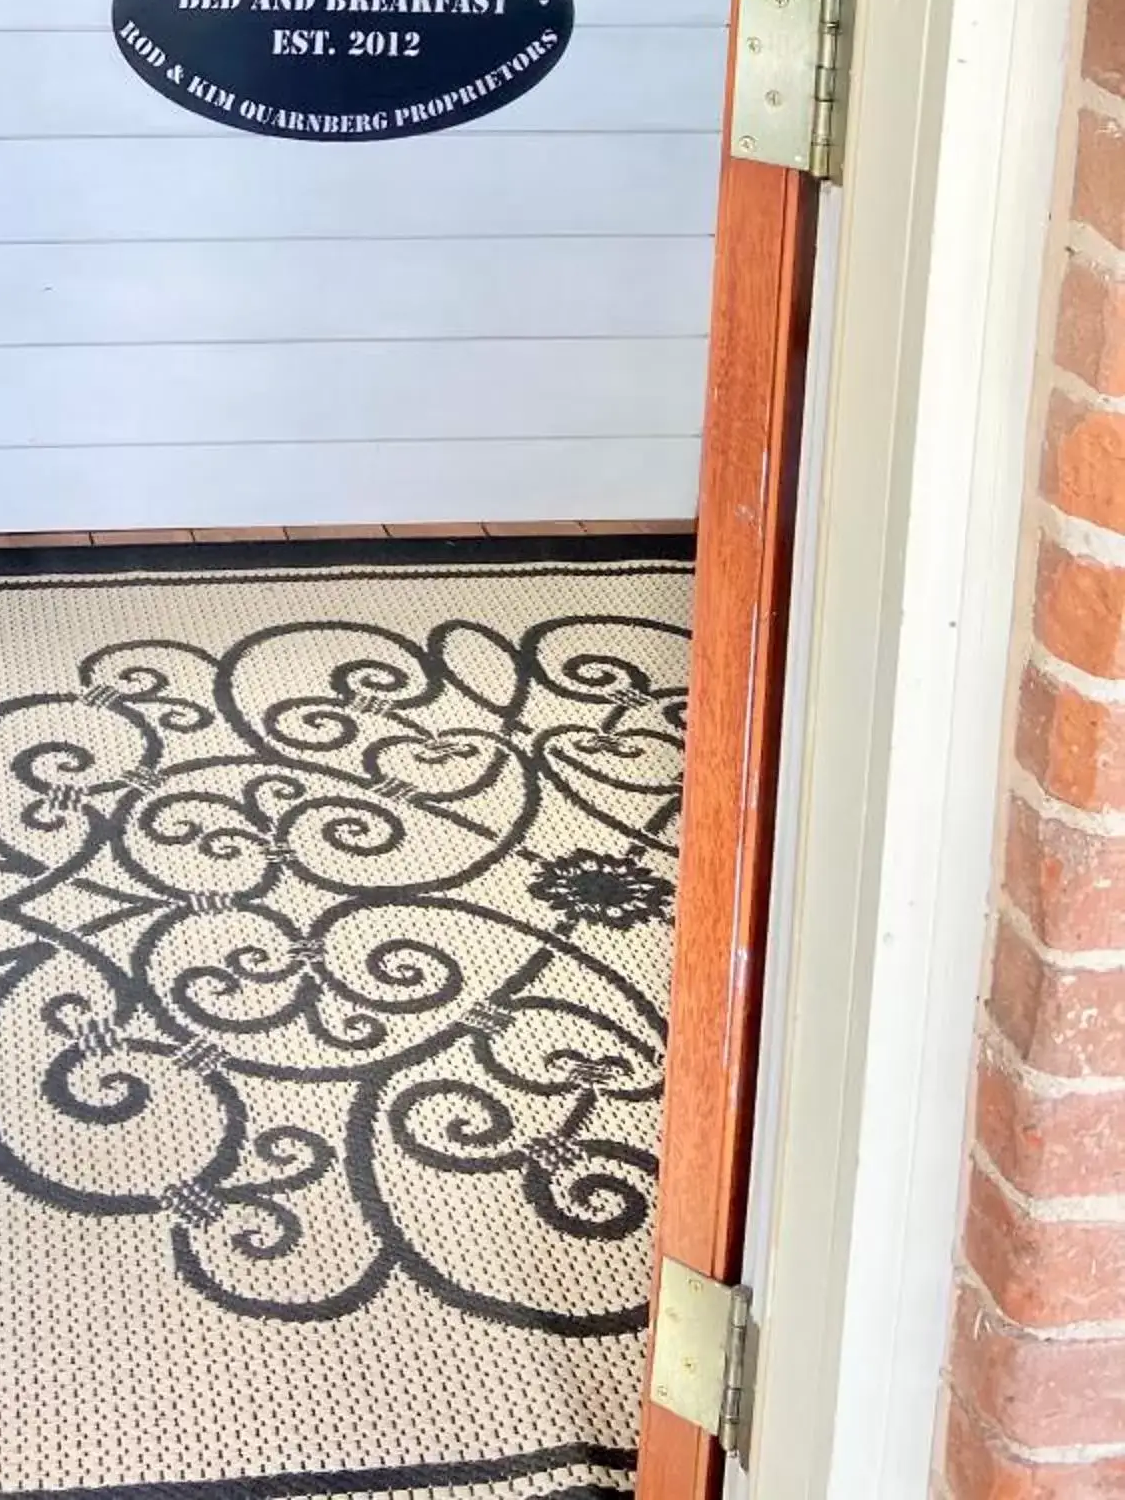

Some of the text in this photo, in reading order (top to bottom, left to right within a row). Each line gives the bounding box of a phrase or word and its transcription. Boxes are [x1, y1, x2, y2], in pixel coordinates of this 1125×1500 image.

[119, 20, 559, 133] ROD & KIM QUARNBERG PROPRIETORS
[271, 29, 421, 57] EST. 2012
